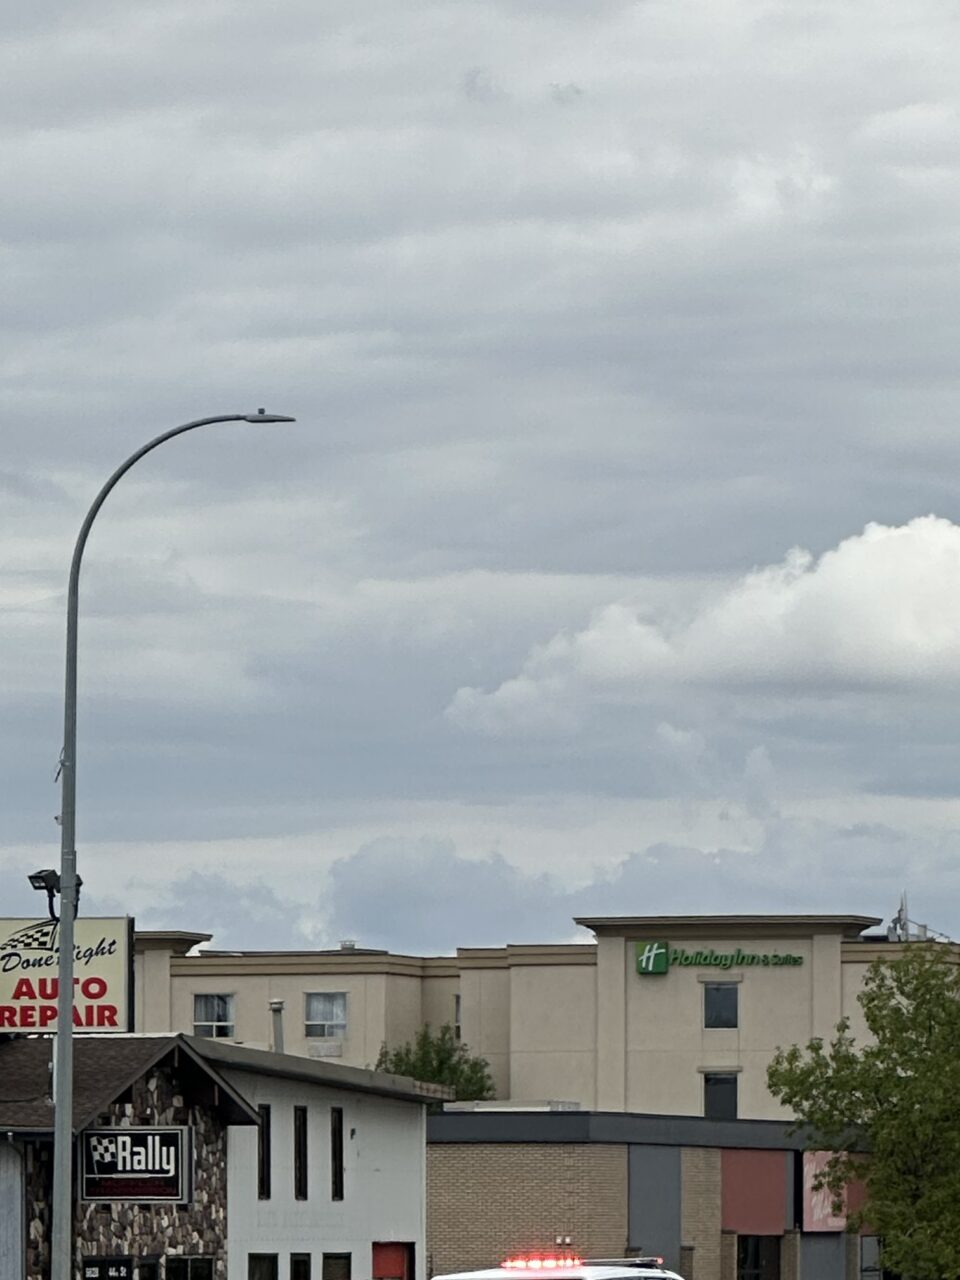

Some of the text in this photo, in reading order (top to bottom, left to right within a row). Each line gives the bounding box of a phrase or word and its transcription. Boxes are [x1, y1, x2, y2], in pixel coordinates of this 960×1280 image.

[55, 937, 117, 966] ight
[669, 949, 733, 969] Holiday
[733, 949, 760, 966] Inn
[116, 1134, 176, 1177] Rally
